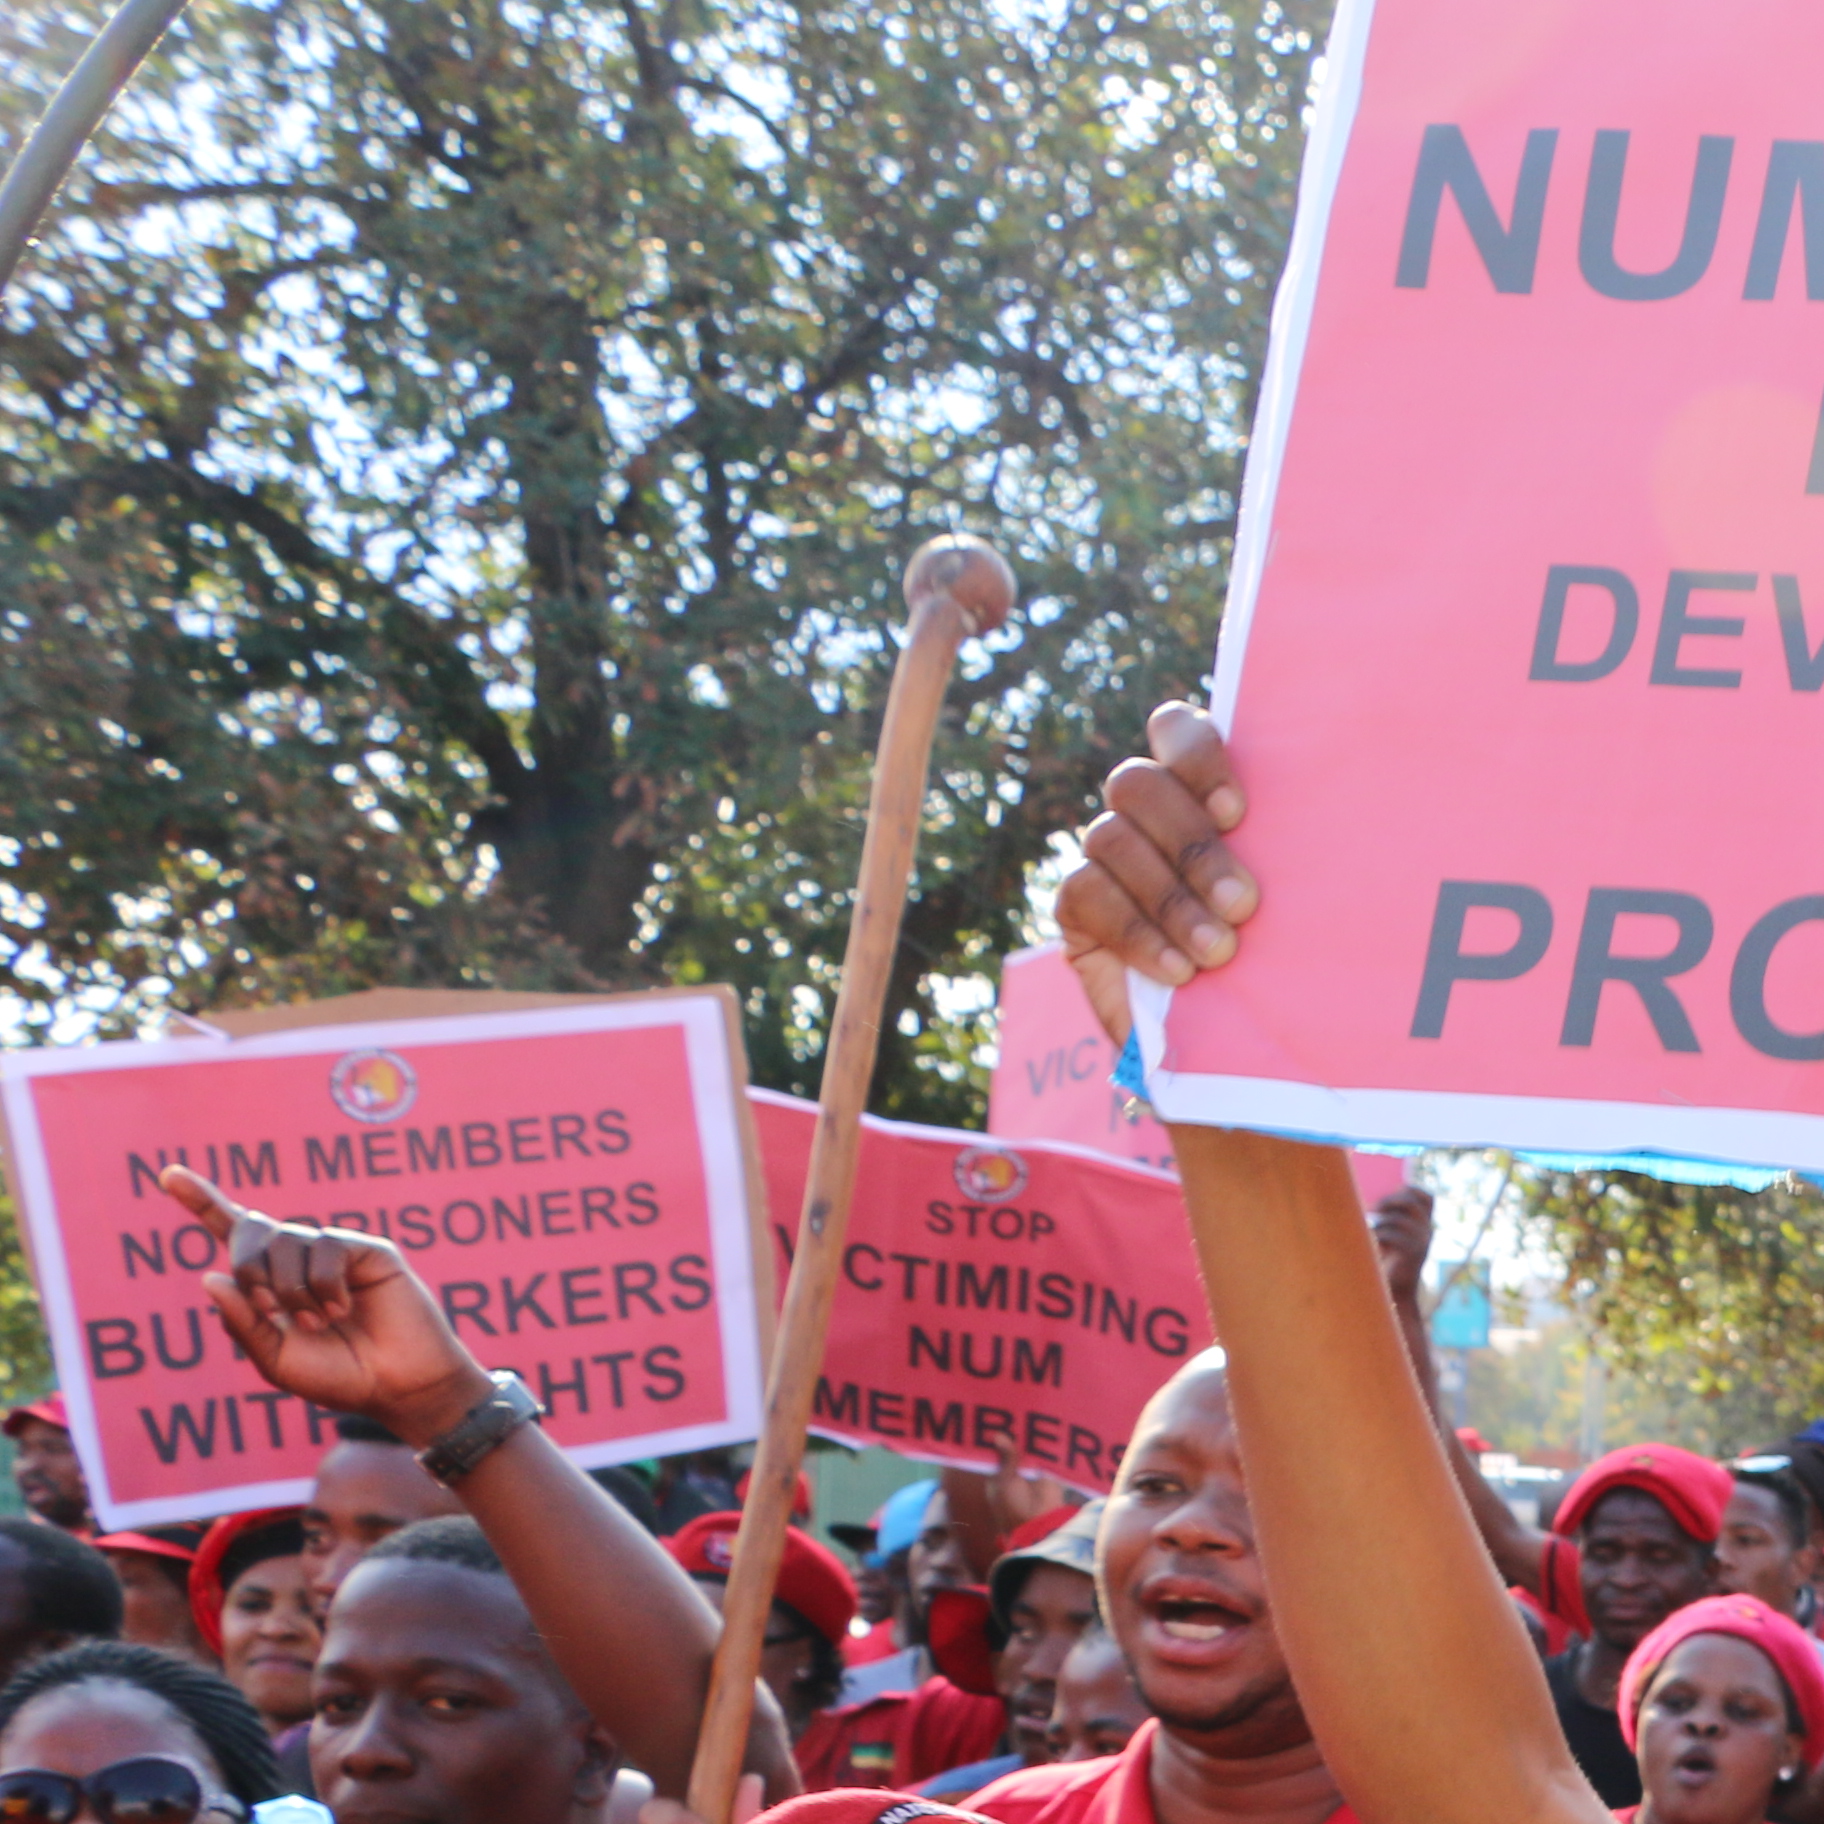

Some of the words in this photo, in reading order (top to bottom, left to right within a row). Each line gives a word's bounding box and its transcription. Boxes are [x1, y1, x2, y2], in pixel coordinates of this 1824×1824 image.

[126, 1140, 281, 1199] NUM
[303, 1108, 631, 1184] MEMBERS
[121, 1222, 217, 1279] NO
[279, 1181, 660, 1251] ISONERS
[925, 1200, 1055, 1242] STOP
[440, 1253, 712, 1337] RKERS
[775, 1222, 1190, 1357] CTIMISING
[908, 1324, 1064, 1388] NUM
